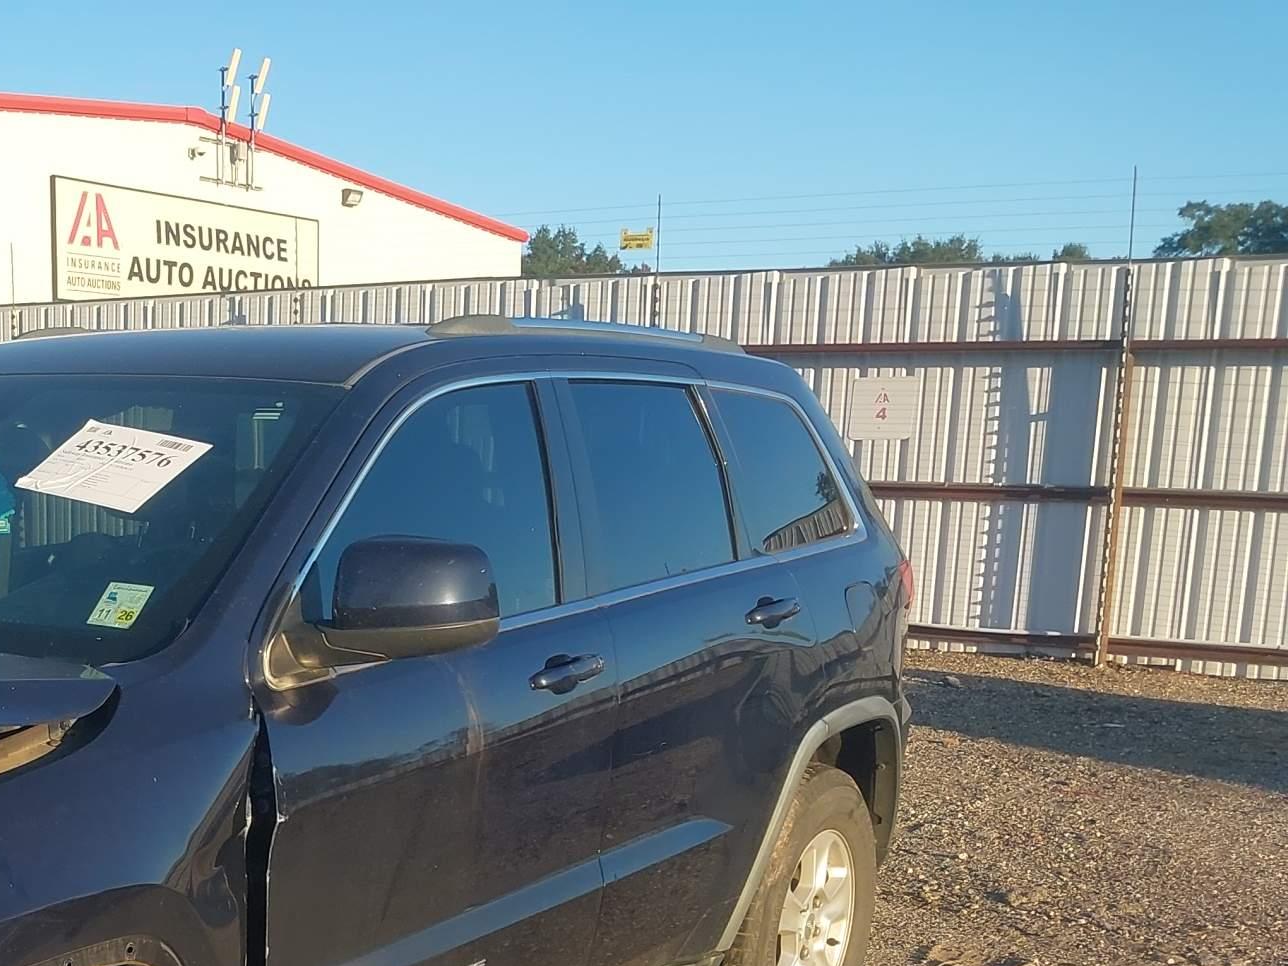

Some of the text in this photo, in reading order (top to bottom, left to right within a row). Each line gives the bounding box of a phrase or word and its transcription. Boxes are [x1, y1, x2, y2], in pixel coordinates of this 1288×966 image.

[155, 219, 289, 263] INSURANCE
[66, 256, 121, 274] INSURANCE
[127, 256, 194, 288] AUTO
[66, 275, 121, 292] AUTO AUCTIONS
[875, 407, 887, 420] 4
[76, 439, 179, 468] 43537576
[97, 608, 135, 621] 11 26
